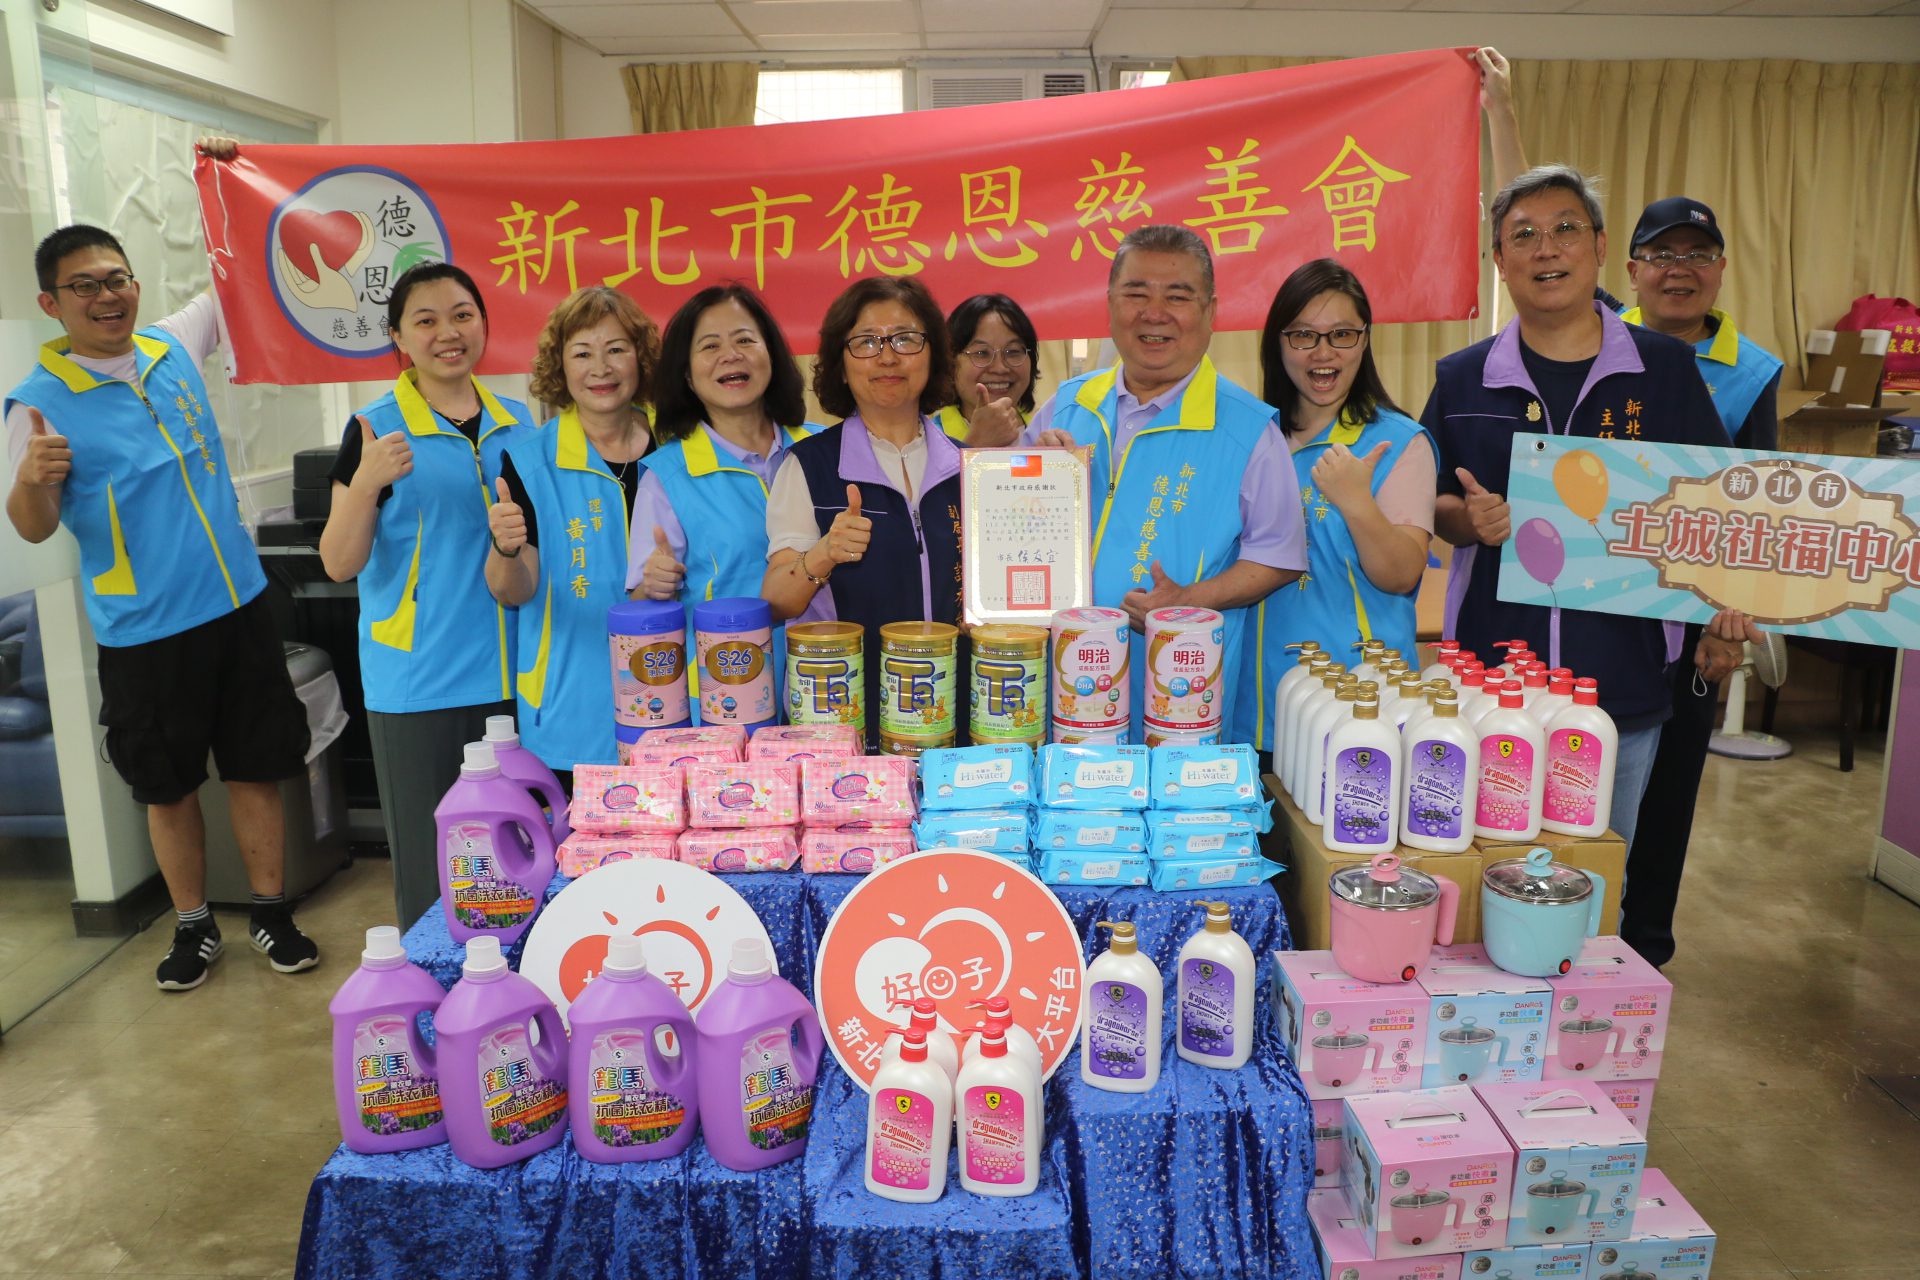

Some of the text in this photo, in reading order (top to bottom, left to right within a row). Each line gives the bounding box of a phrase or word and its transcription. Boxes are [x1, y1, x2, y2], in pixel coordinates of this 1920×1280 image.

[490, 135, 1411, 294] 新北市德恩慈善會
[359, 195, 416, 305] 德恩
[1625, 399, 1642, 441] 新北
[1170, 463, 1196, 514] 新北市
[1728, 470, 1844, 503] 新北市
[1129, 475, 1170, 583] 德恩慈善會
[566, 517, 591, 598] 黃月香
[1060, 632, 1078, 642] meiji
[1155, 634, 1174, 643] meiji
[644, 649, 676, 668] S-26
[717, 648, 752, 667] S-26
[1079, 648, 1109, 663] 明治
[1174, 650, 1205, 665] 明治
[763, 686, 770, 700] 3
[1418, 773, 1457, 797] dragonhorse
[1484, 767, 1525, 790] dragonhorse
[1553, 760, 1592, 785] dragonhorse
[1343, 780, 1384, 802] dragonhorse
[815, 801, 823, 809] 80
[451, 855, 494, 877] 龍馬
[455, 886, 517, 902] 抗菌洗衣精
[882, 957, 992, 1013] 好 子
[1188, 991, 1227, 1017] dragonhorse
[1097, 1014, 1139, 1037] dragonhorse
[358, 1052, 409, 1080] 龍馬
[483, 1058, 531, 1093] 龍馬
[593, 1066, 645, 1091] 龍馬
[745, 1063, 792, 1098] 龍馬
[362, 1083, 436, 1109] 抗菌洗衣精
[491, 1084, 554, 1122] 抗菌洗衣精
[596, 1097, 668, 1119] 抗菌洗衣精
[750, 1088, 811, 1125] 抗菌洗衣精
[881, 1121, 925, 1148] dragonhorse
[972, 1119, 1018, 1141] dragonhorse
